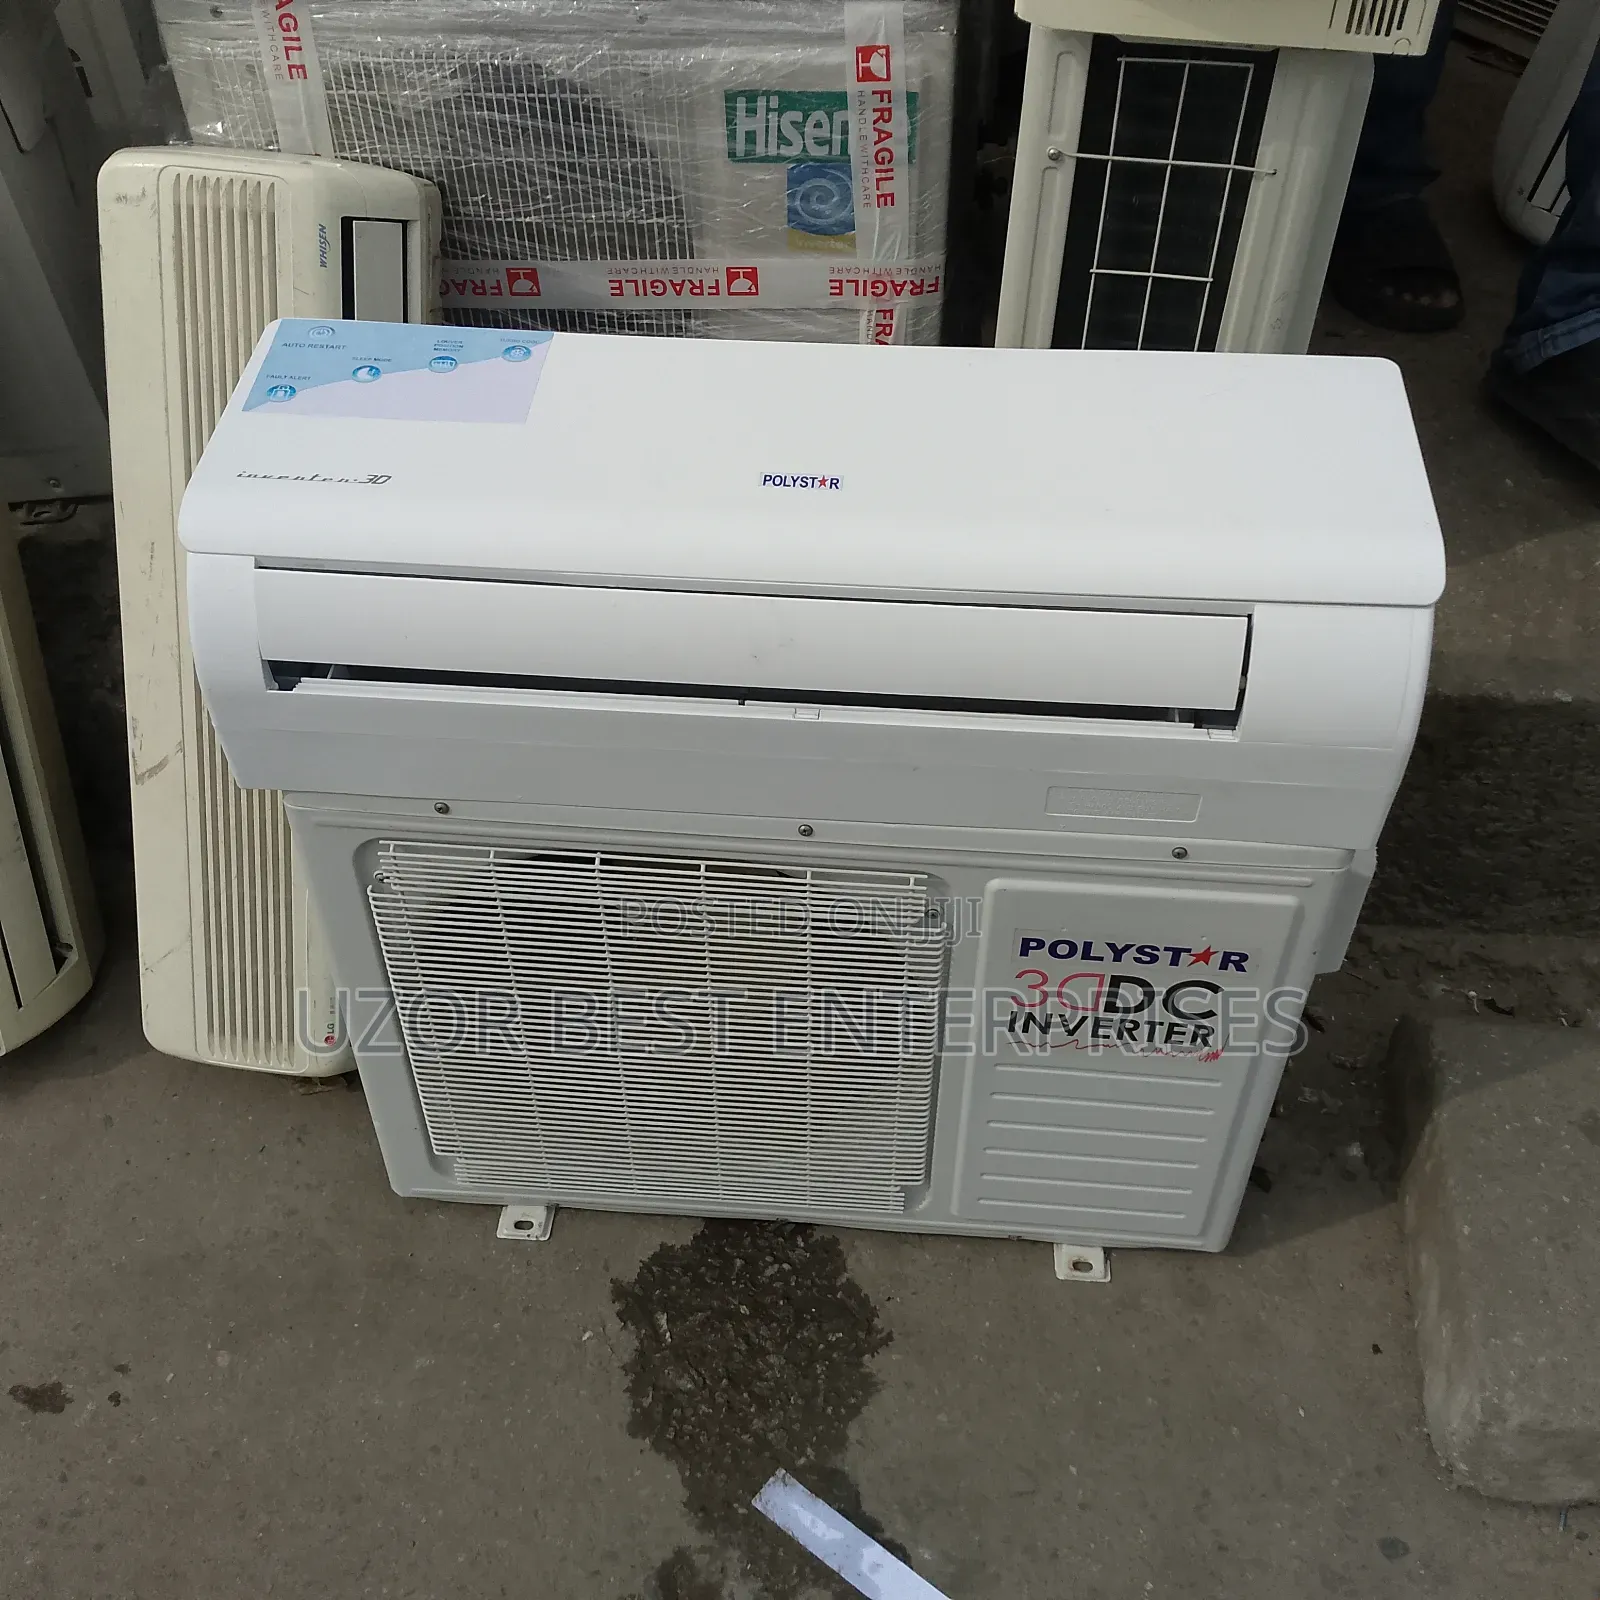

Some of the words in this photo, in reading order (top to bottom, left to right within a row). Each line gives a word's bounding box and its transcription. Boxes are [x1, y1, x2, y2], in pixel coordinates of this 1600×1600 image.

[735, 95, 850, 158] Hisen
[871, 89, 895, 209] FRAGILE
[318, 223, 331, 268] WHISEN
[608, 279, 720, 297] FRAGILE
[828, 275, 940, 298] FRAGILE
[1007, 1010, 1216, 1048] INVERTER
